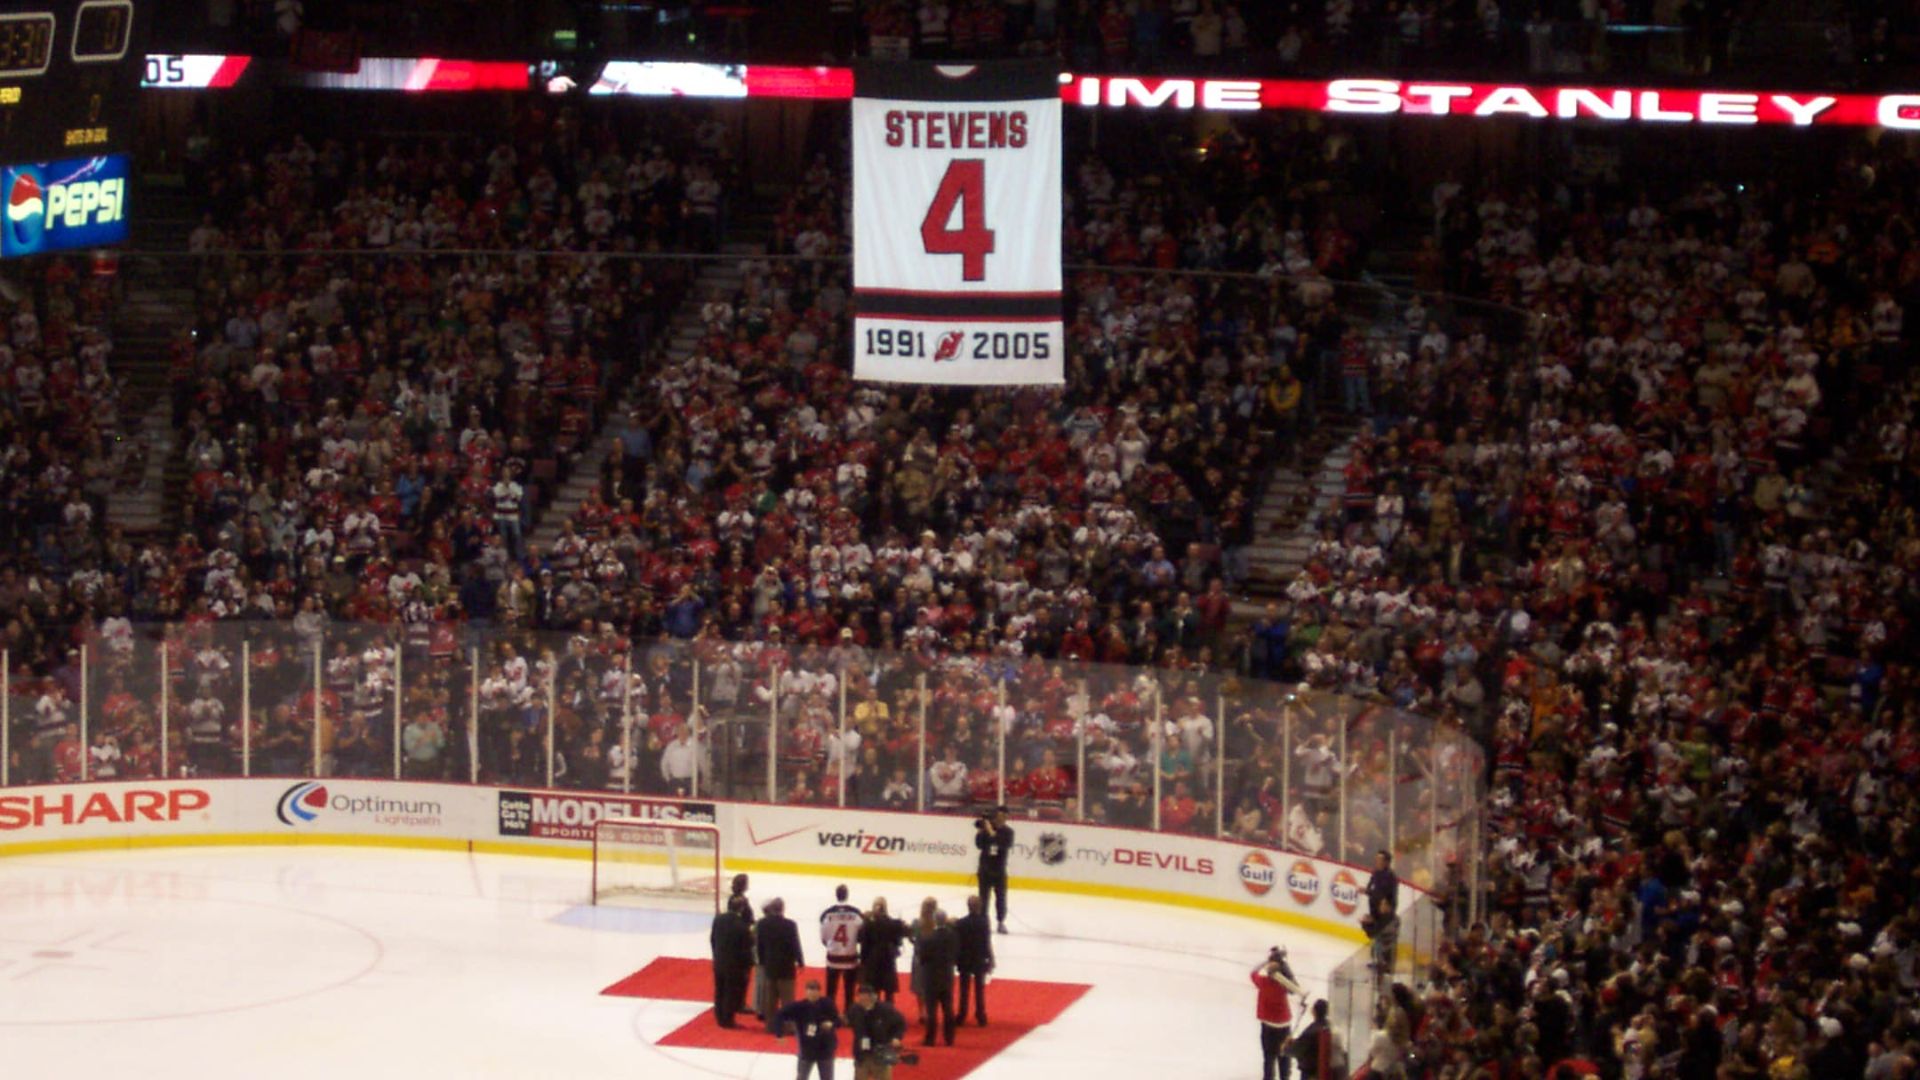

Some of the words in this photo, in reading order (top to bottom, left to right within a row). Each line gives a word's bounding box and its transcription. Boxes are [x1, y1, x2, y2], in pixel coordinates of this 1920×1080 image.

[1058, 72, 1262, 110] IME
[1327, 79, 1838, 126] STANLEY
[885, 110, 1028, 149] STEVENS
[45, 178, 124, 230] PEPSI
[920, 158, 996, 282] 4
[866, 329, 925, 358] 1991
[972, 332, 1050, 360] 2005
[0, 788, 211, 830] SHARP
[331, 794, 442, 815] Optimum
[1113, 848, 1214, 875] DEVILS
[1240, 864, 1274, 881] Gulf
[1287, 874, 1320, 892] Gulf
[1330, 883, 1359, 901] Gulf
[832, 923, 849, 948] 4
